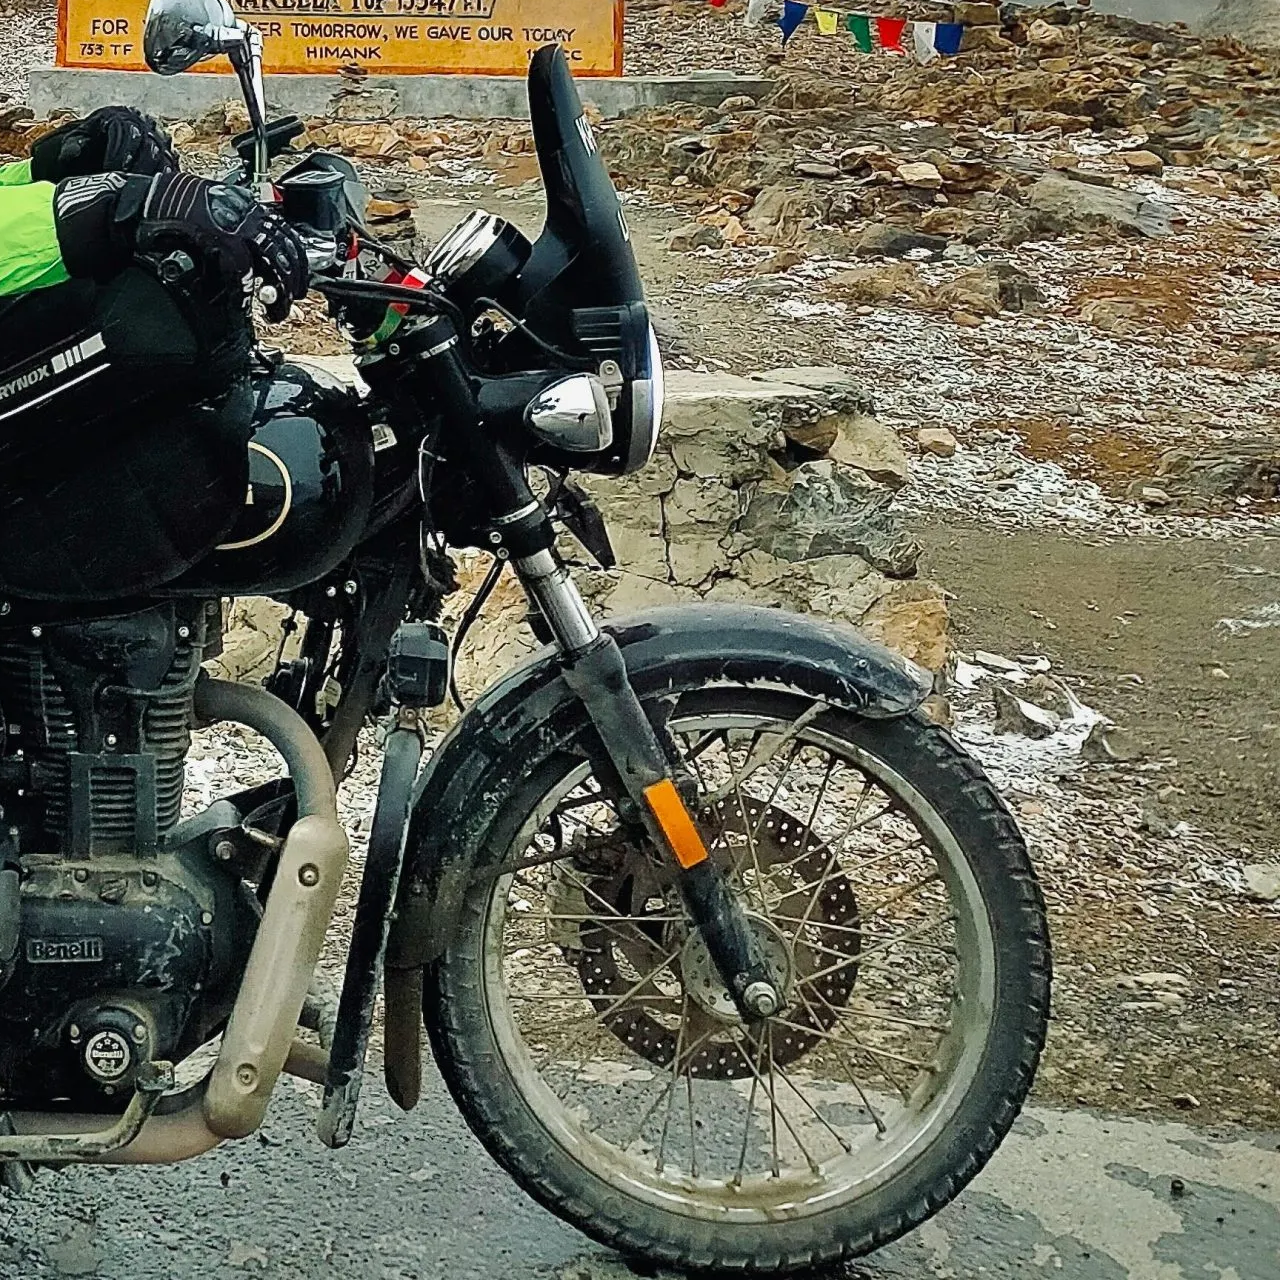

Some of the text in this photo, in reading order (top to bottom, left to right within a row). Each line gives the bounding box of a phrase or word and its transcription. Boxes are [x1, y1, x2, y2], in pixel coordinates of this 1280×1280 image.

[92, 19, 129, 35] FOR
[291, 22, 389, 42] TOMORROW,
[395, 24, 419, 39] WE
[426, 25, 471, 40] GAVE
[478, 26, 513, 41] OUR
[522, 27, 576, 42] TODAY
[306, 46, 382, 60] HIMANK
[32, 938, 101, 959] Benelli
